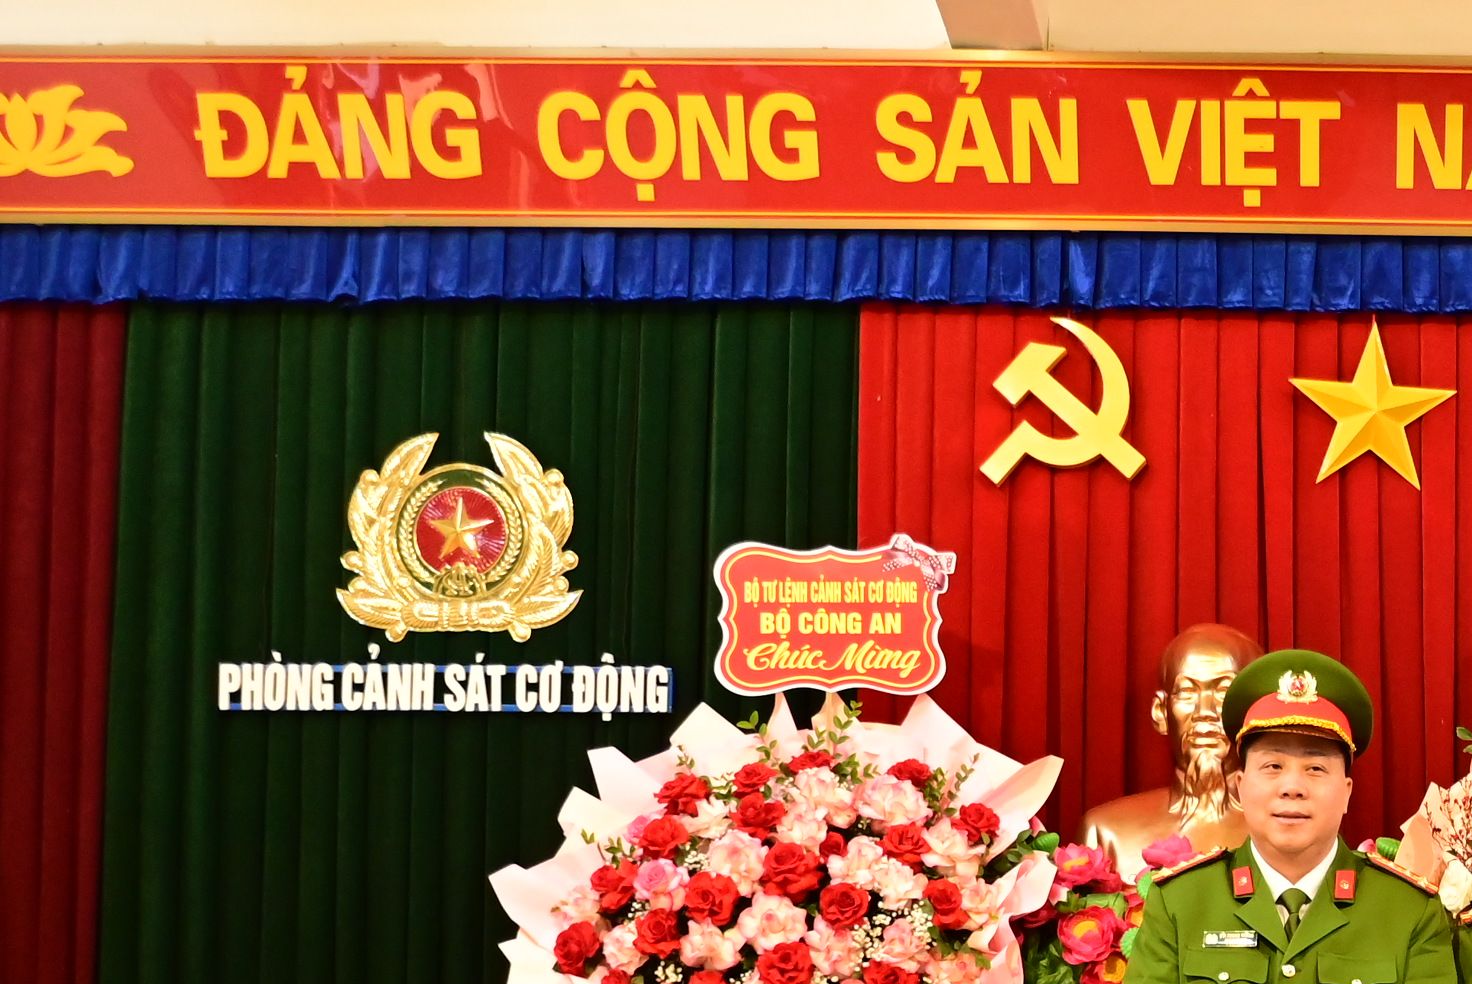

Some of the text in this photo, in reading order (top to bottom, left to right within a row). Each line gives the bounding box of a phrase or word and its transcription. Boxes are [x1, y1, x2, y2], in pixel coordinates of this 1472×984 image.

[194, 65, 482, 179] ĐẢNG
[538, 70, 819, 201] CỘNG
[876, 70, 1078, 184] SẢN
[1127, 79, 1340, 206] VIỆT
[744, 574, 917, 607] BỘ TƯ LỆNH CẢNH SÁT CƠ ĐỘNG
[760, 608, 902, 638] BỘ CÔNG AN
[743, 639, 921, 678] Chúc Mừng
[218, 642, 670, 722] PHÒNG CẢNH SÁT CƠ ĐỘNG
